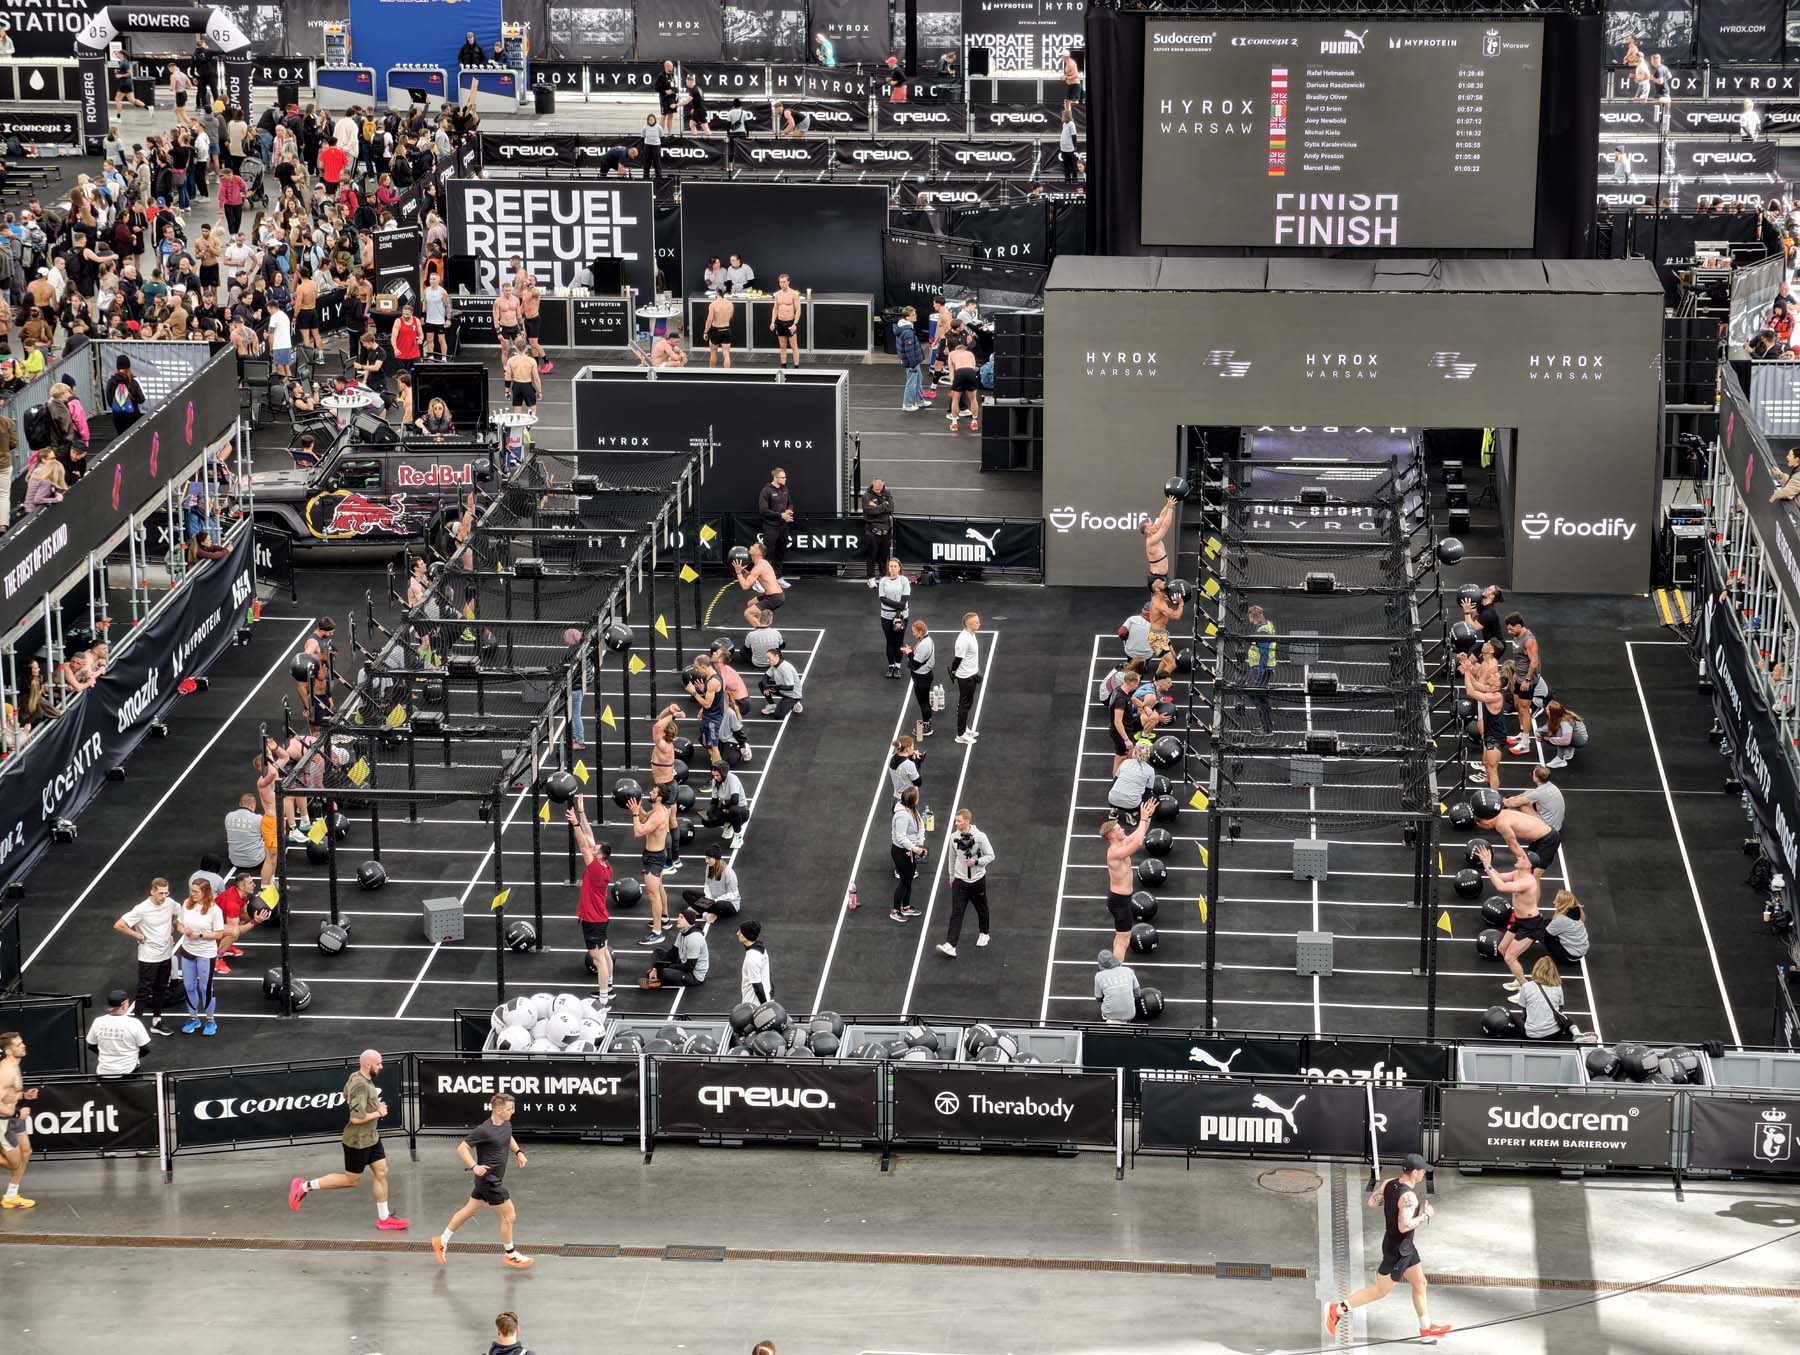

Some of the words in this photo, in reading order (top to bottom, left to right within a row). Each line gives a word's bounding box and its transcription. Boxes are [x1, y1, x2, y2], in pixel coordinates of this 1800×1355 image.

[1046, 2, 1084, 11] HYRO
[128, 14, 190, 28] ROWERG
[658, 21, 700, 29] HYROX
[828, 23, 869, 32] HYROX
[90, 27, 108, 39] 05
[212, 29, 231, 42] 05
[1719, 25, 1767, 34] HYROX.COM
[964, 34, 1034, 47] HYDRATE
[1042, 34, 1085, 47] HYDR
[1153, 32, 1213, 44] Sudocrem
[1247, 38, 1289, 47] concept
[1291, 38, 1299, 47] 2
[1320, 40, 1360, 54] PUMA
[1404, 39, 1458, 47] MYPROTEIN
[595, 73, 652, 85] HYRO
[703, 74, 759, 87] YROX
[1716, 78, 1793, 90] HYROX
[808, 77, 865, 95] HYROX
[83, 72, 97, 124] ROWERG
[1160, 99, 1254, 115] HYROX
[12, 123, 61, 134] concept
[64, 124, 72, 133] 2
[1160, 122, 1253, 134] WARSAW
[661, 148, 709, 159] rewo.
[464, 187, 638, 225] REFUEL
[1275, 214, 1398, 246] FINISH
[466, 224, 639, 261] REFUEL
[983, 242, 1031, 259] YROX
[581, 318, 622, 326] HYROX
[1086, 351, 1157, 363] HYROX
[1306, 353, 1379, 365] HYROX
[1530, 354, 1603, 367] HYROX
[1086, 368, 1157, 377] WARSAW
[1306, 370, 1378, 379] WARSAW
[1529, 371, 1602, 380] WARSAW
[598, 437, 649, 446] HYROX
[762, 439, 813, 449] HYROX
[1553, 517, 1637, 540] foodify
[932, 542, 986, 561] PUMA
[3, 569, 17, 600] THE
[16, 552, 34, 588] FIRST
[33, 544, 42, 572] OF
[41, 535, 53, 564] ITS
[52, 522, 68, 555] KIND
[183, 606, 223, 660] MYPROTEIN
[54, 730, 103, 801] CENTR
[437, 1075, 495, 1095] RACE
[499, 1075, 540, 1095] FOR
[544, 1076, 622, 1096] IMPACT
[239, 1089, 350, 1115] concep
[698, 1085, 836, 1114] qrewo.
[523, 1103, 578, 1112] HYROX
[968, 1094, 1075, 1122] Therabody
[1487, 1137, 1526, 1147] EXPERT
[1529, 1138, 1560, 1148] KREM
[1563, 1139, 1628, 1150] BARIEROWY
